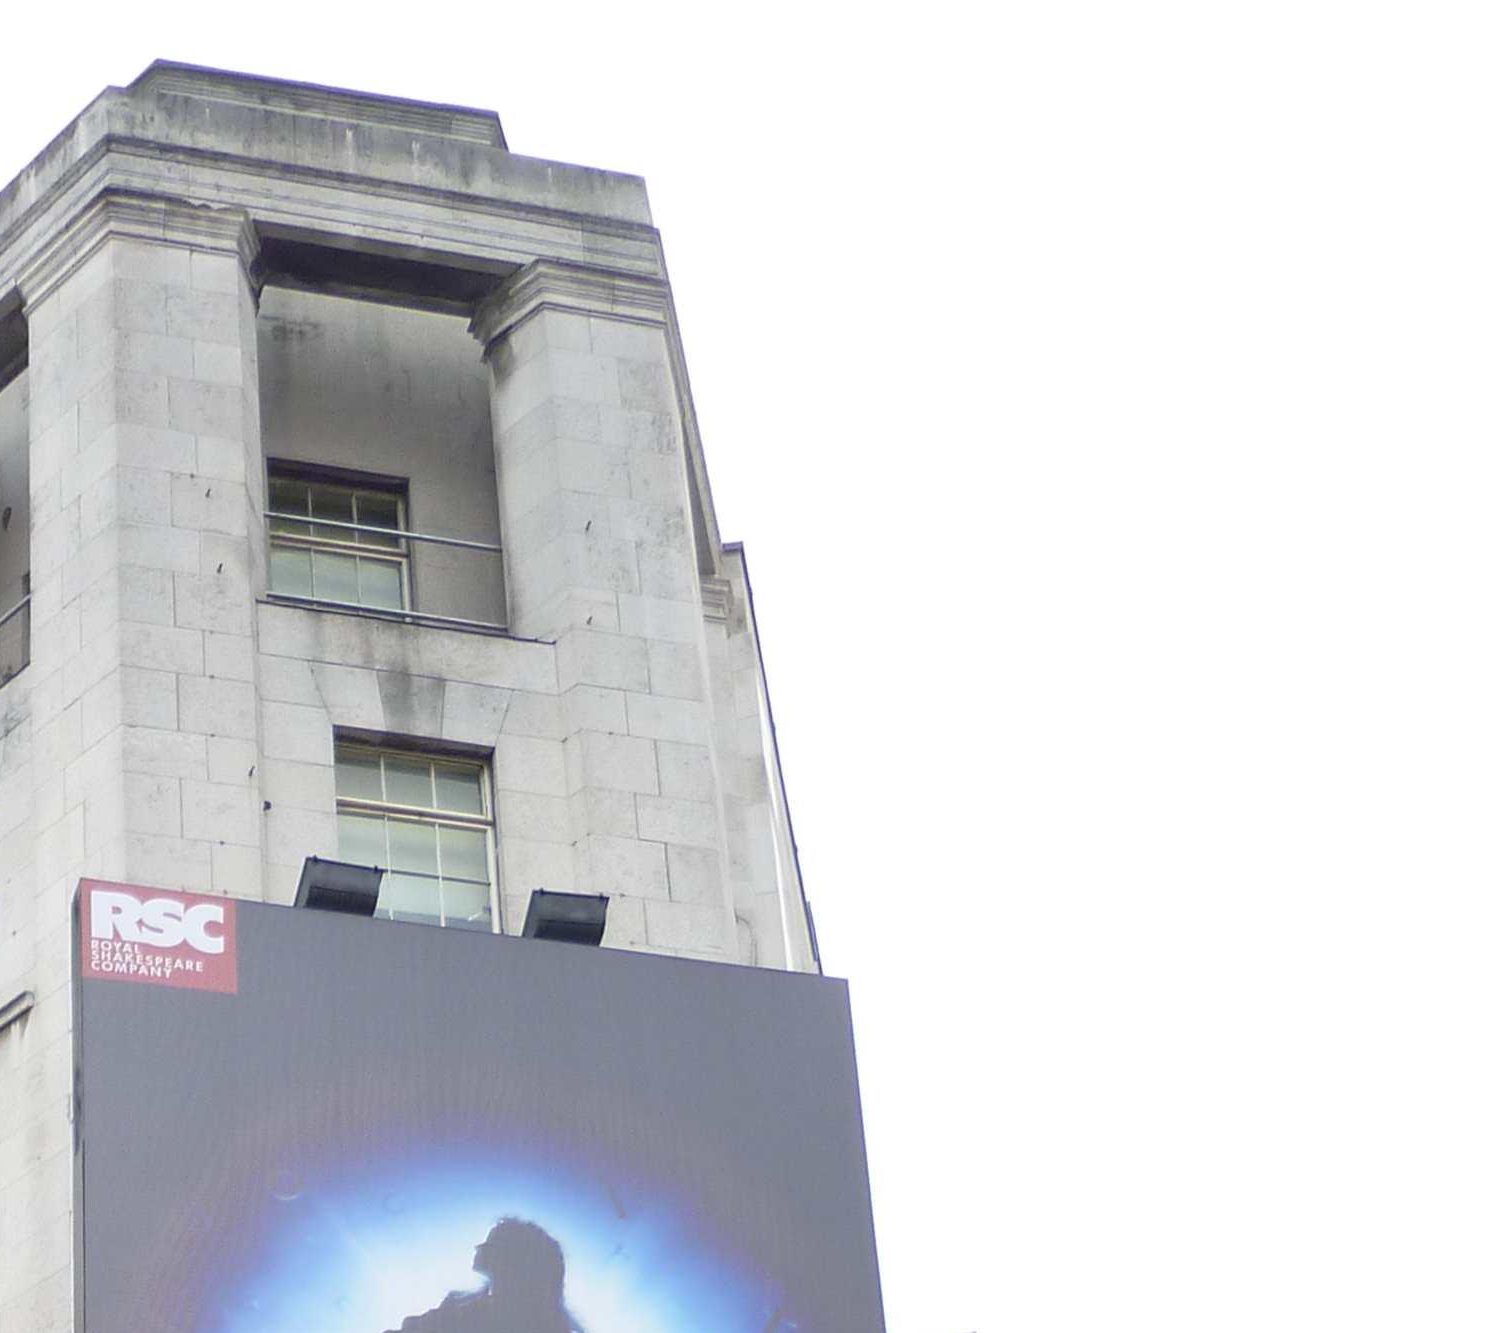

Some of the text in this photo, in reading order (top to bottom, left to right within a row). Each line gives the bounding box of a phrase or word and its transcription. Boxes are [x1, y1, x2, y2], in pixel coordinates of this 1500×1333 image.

[91, 890, 224, 954] RSC
[91, 940, 141, 954] ROYAL
[91, 951, 204, 972] SHAKESPEARE
[91, 961, 172, 978] COMPANY
